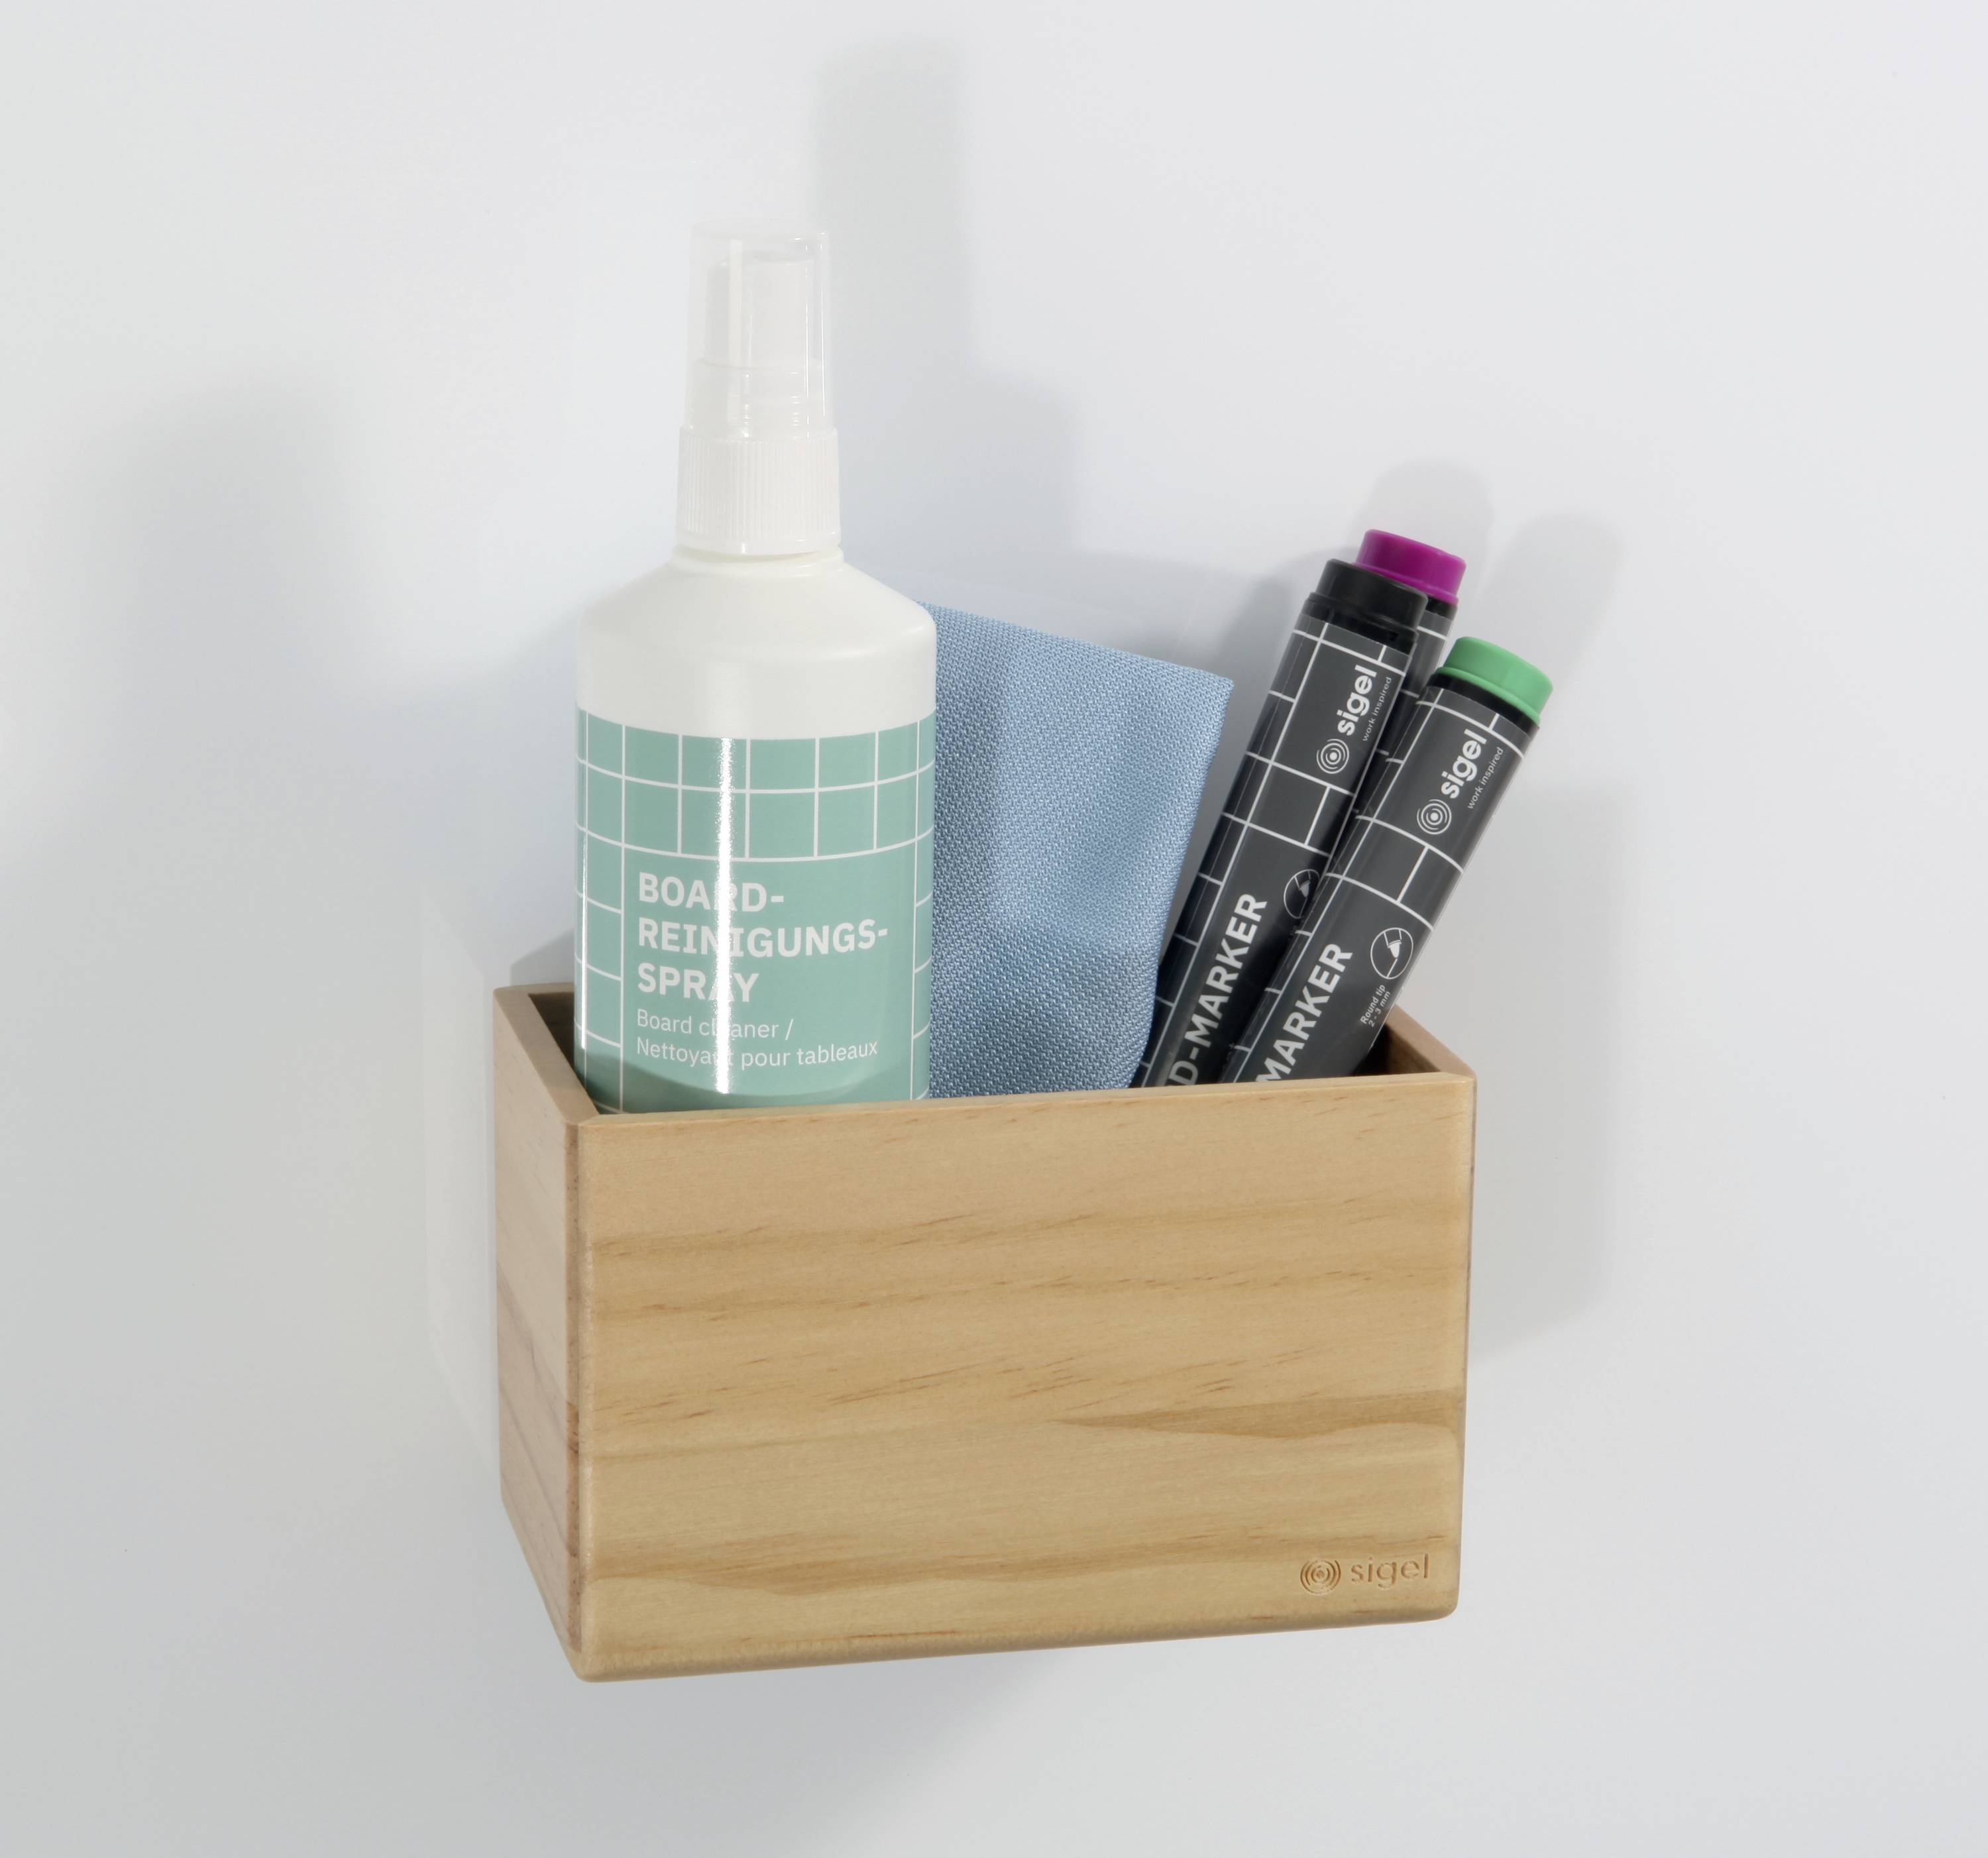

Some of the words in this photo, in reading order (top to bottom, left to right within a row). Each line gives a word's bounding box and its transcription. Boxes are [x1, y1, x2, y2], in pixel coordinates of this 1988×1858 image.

[1337, 665, 1377, 736] sigel
[1363, 718, 1376, 741] work
[1372, 677, 1392, 716] inspired
[1441, 729, 1487, 799] sigel
[1468, 786, 1483, 809] work
[1479, 747, 1504, 785] inspired
[639, 872, 784, 912] BOARD-
[639, 917, 888, 958] REINIGUNGS-
[637, 962, 759, 1002] SPRAY
[1380, 991, 1390, 1007] mm
[637, 1009, 692, 1034] Board
[699, 1017, 779, 1038] claner
[785, 1018, 794, 1040] /
[1255, 944, 1353, 1081] MARKER
[1360, 996, 1378, 1024] Round
[1376, 985, 1386, 996] tip
[637, 1037, 734, 1067] Nettoyat
[742, 1051, 791, 1071] pour
[797, 1041, 878, 1066] tableaux
[1351, 1553, 1429, 1589] sigel
